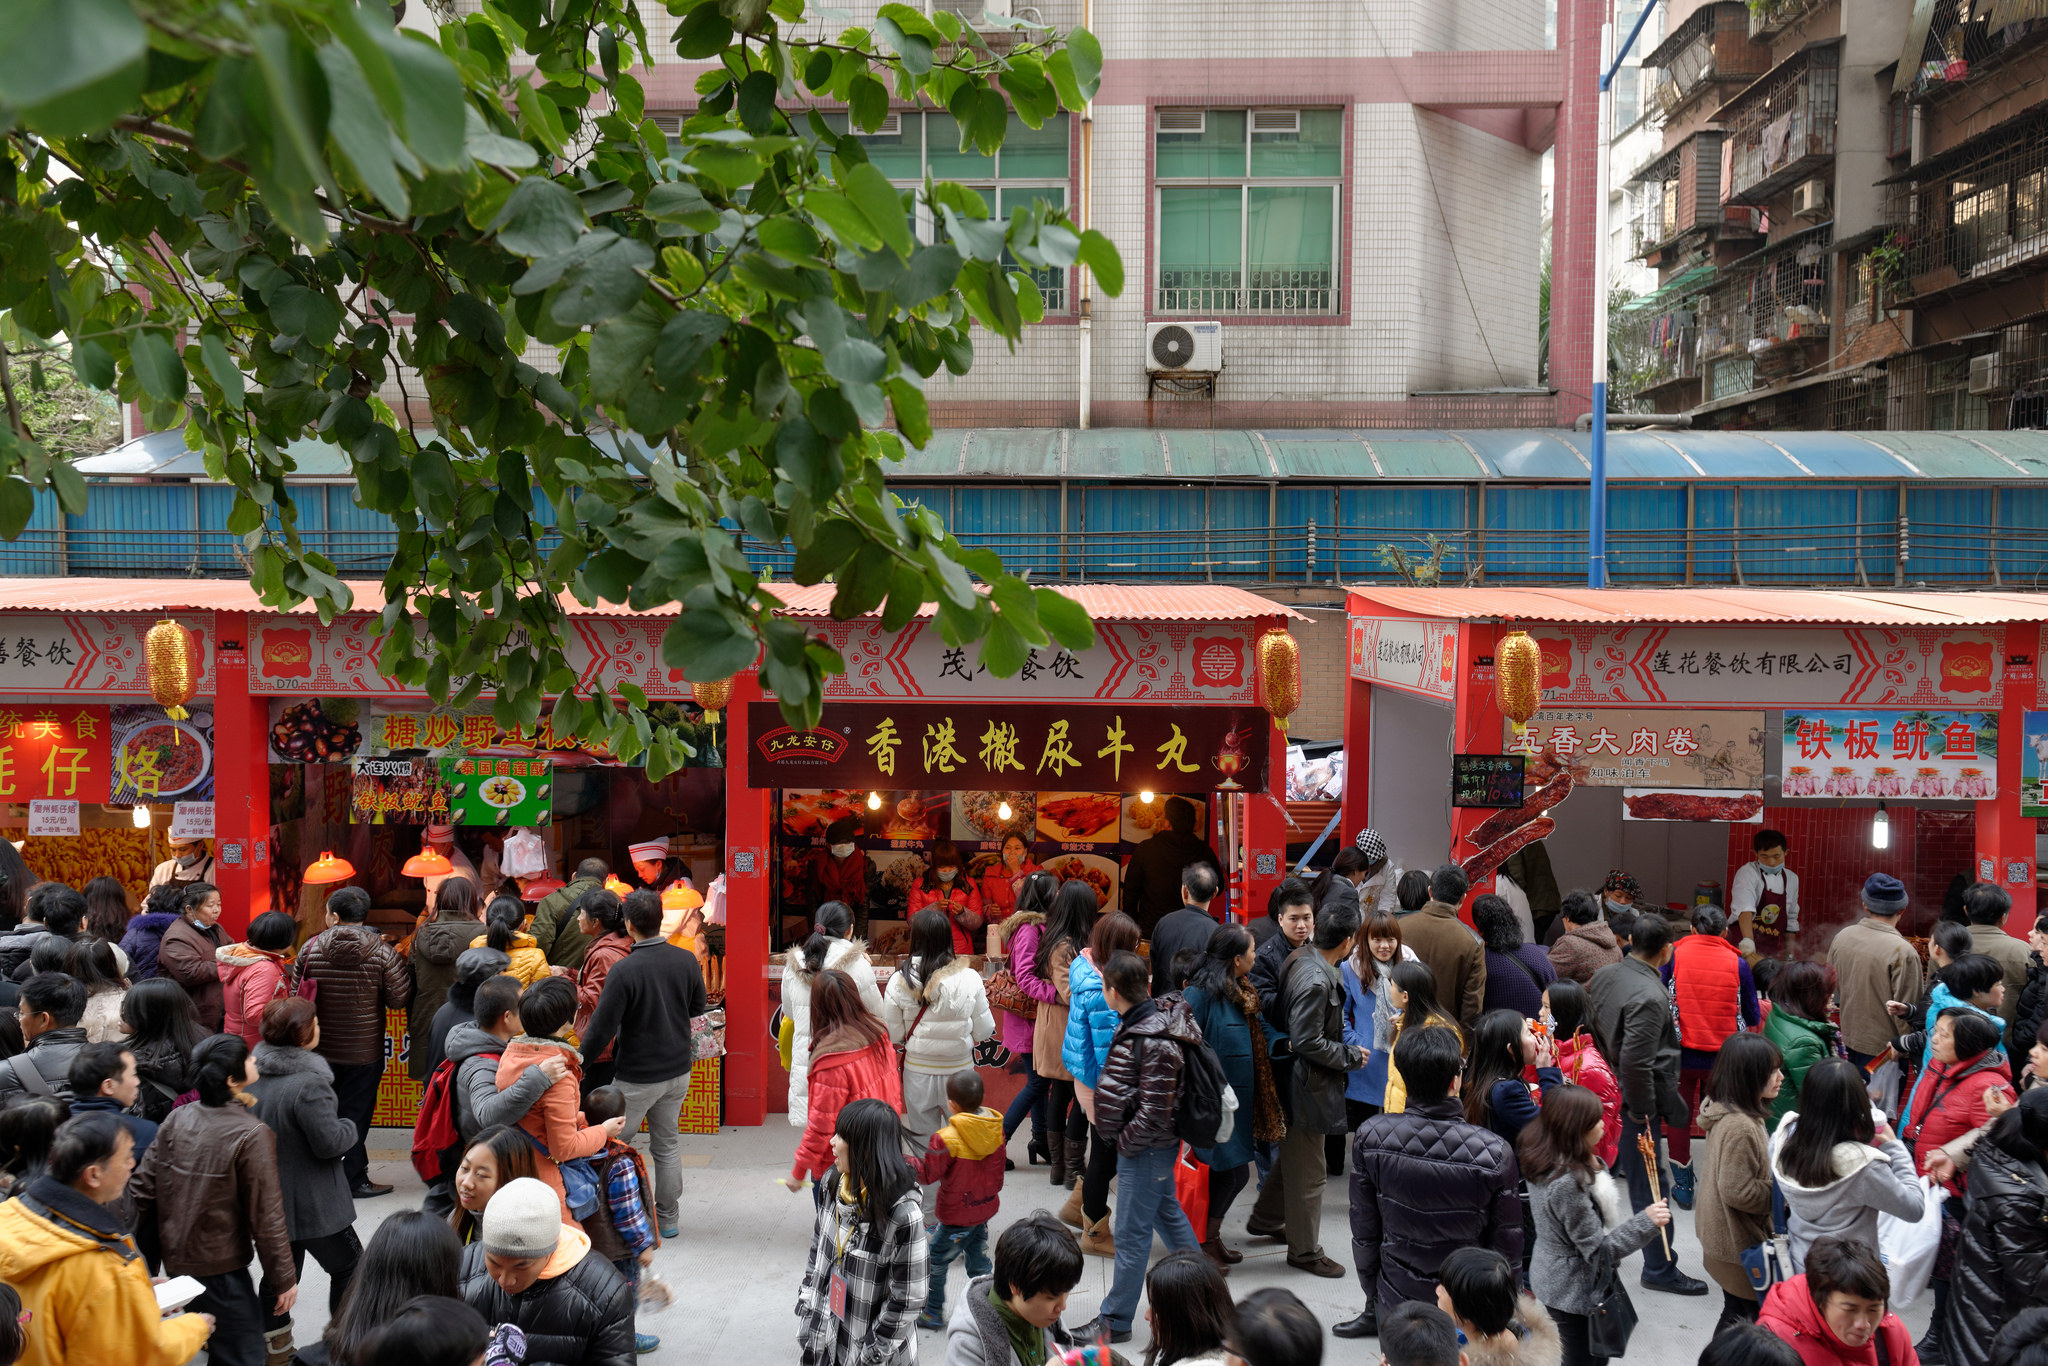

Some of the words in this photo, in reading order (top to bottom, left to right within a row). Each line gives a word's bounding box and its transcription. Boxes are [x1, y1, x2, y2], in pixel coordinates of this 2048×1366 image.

[938, 648, 1084, 681] 茂餐饮
[1652, 650, 1852, 676] 莲花餐饮有限公司
[276, 679, 299, 689] D70
[1541, 689, 1557, 700] 71
[0, 709, 101, 740] 统美食
[770, 735, 835, 752] 九龙安仔
[1508, 725, 1700, 756] 五香大肉卷
[1795, 719, 1978, 761] 铁板鱿鱼
[865, 715, 1201, 782] 香港撒尿牛丸
[460, 760, 546, 776] 泰国榴莲酥
[1621, 757, 1671, 767] 闻香下马
[1589, 768, 1651, 779] 知味泊车
[357, 790, 449, 812] 铁板鱿鱼
[178, 806, 215, 815] 潮州蚝仔
[41, 816, 68, 824] 15元/份
[186, 818, 212, 826] 15元/份
